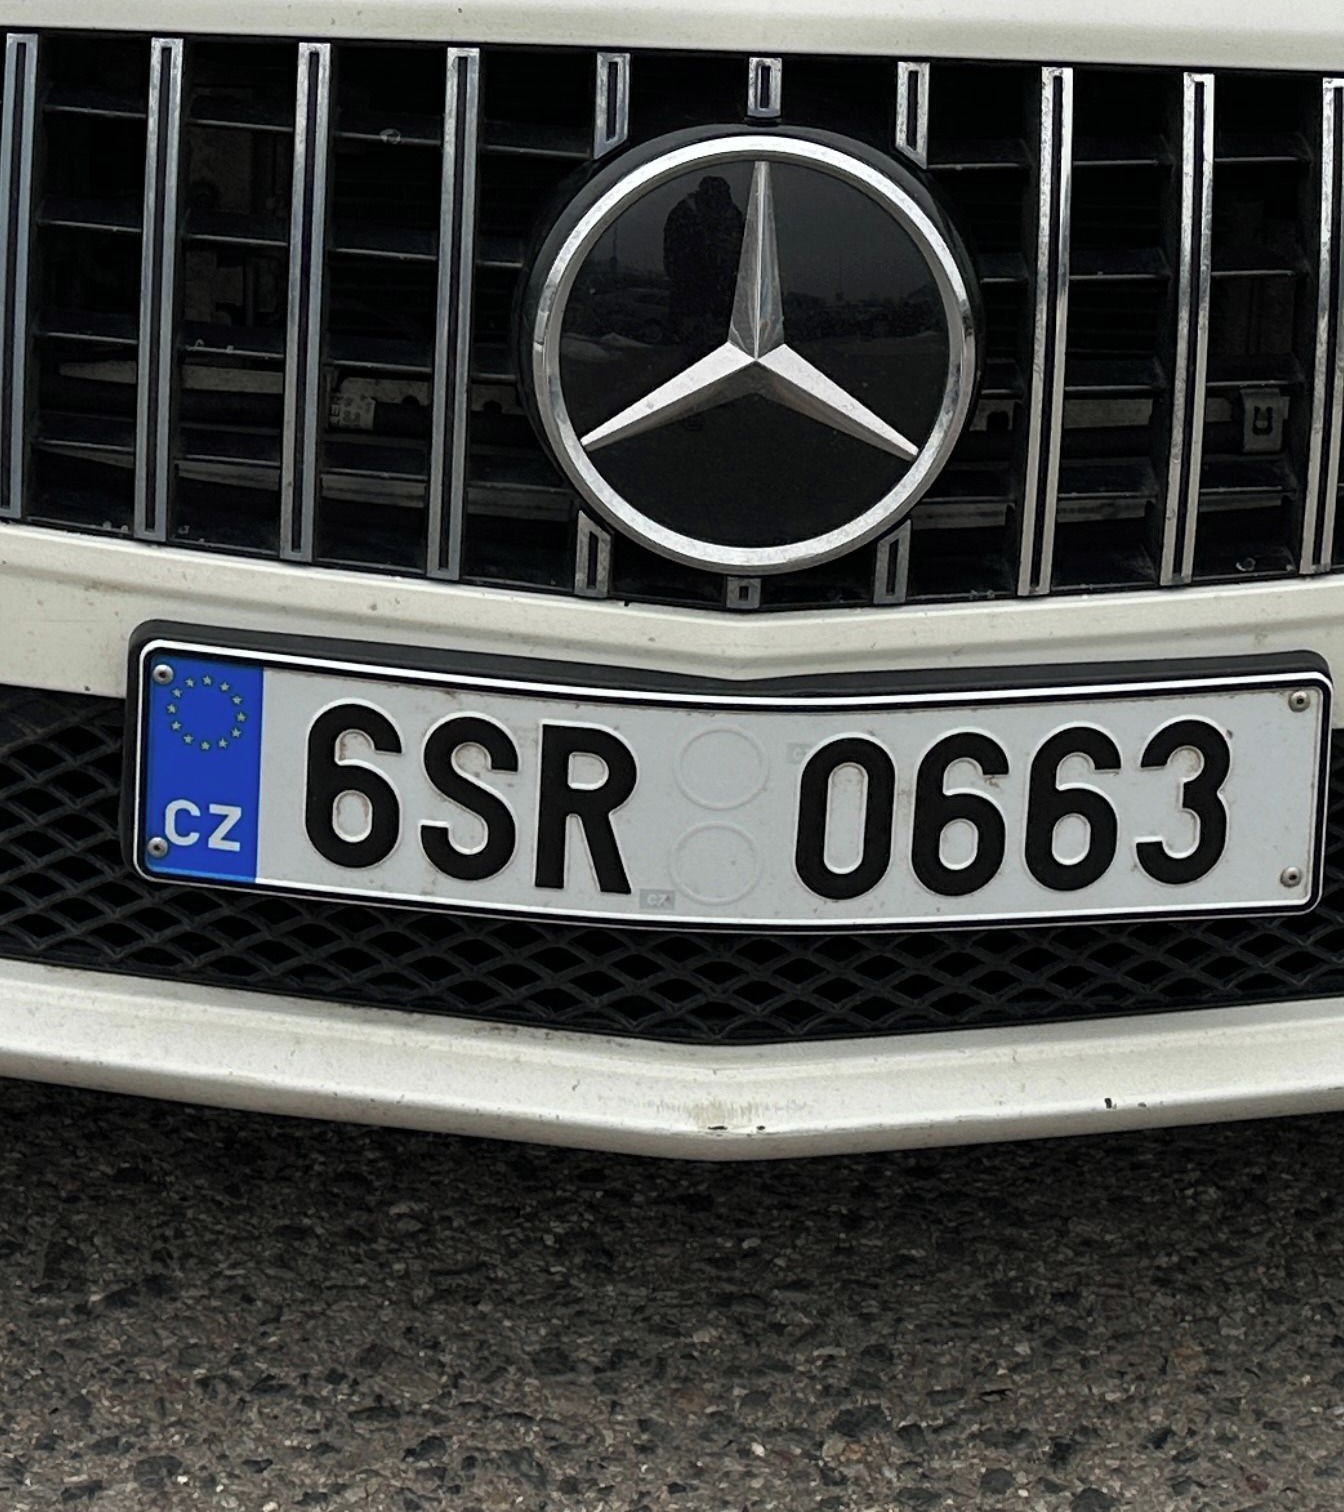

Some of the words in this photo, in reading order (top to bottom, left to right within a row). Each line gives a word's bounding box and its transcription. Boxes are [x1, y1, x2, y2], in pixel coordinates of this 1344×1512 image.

[164, 798, 242, 852] CZ
[304, 702, 638, 895] 6SR
[794, 719, 1231, 901] 0663
